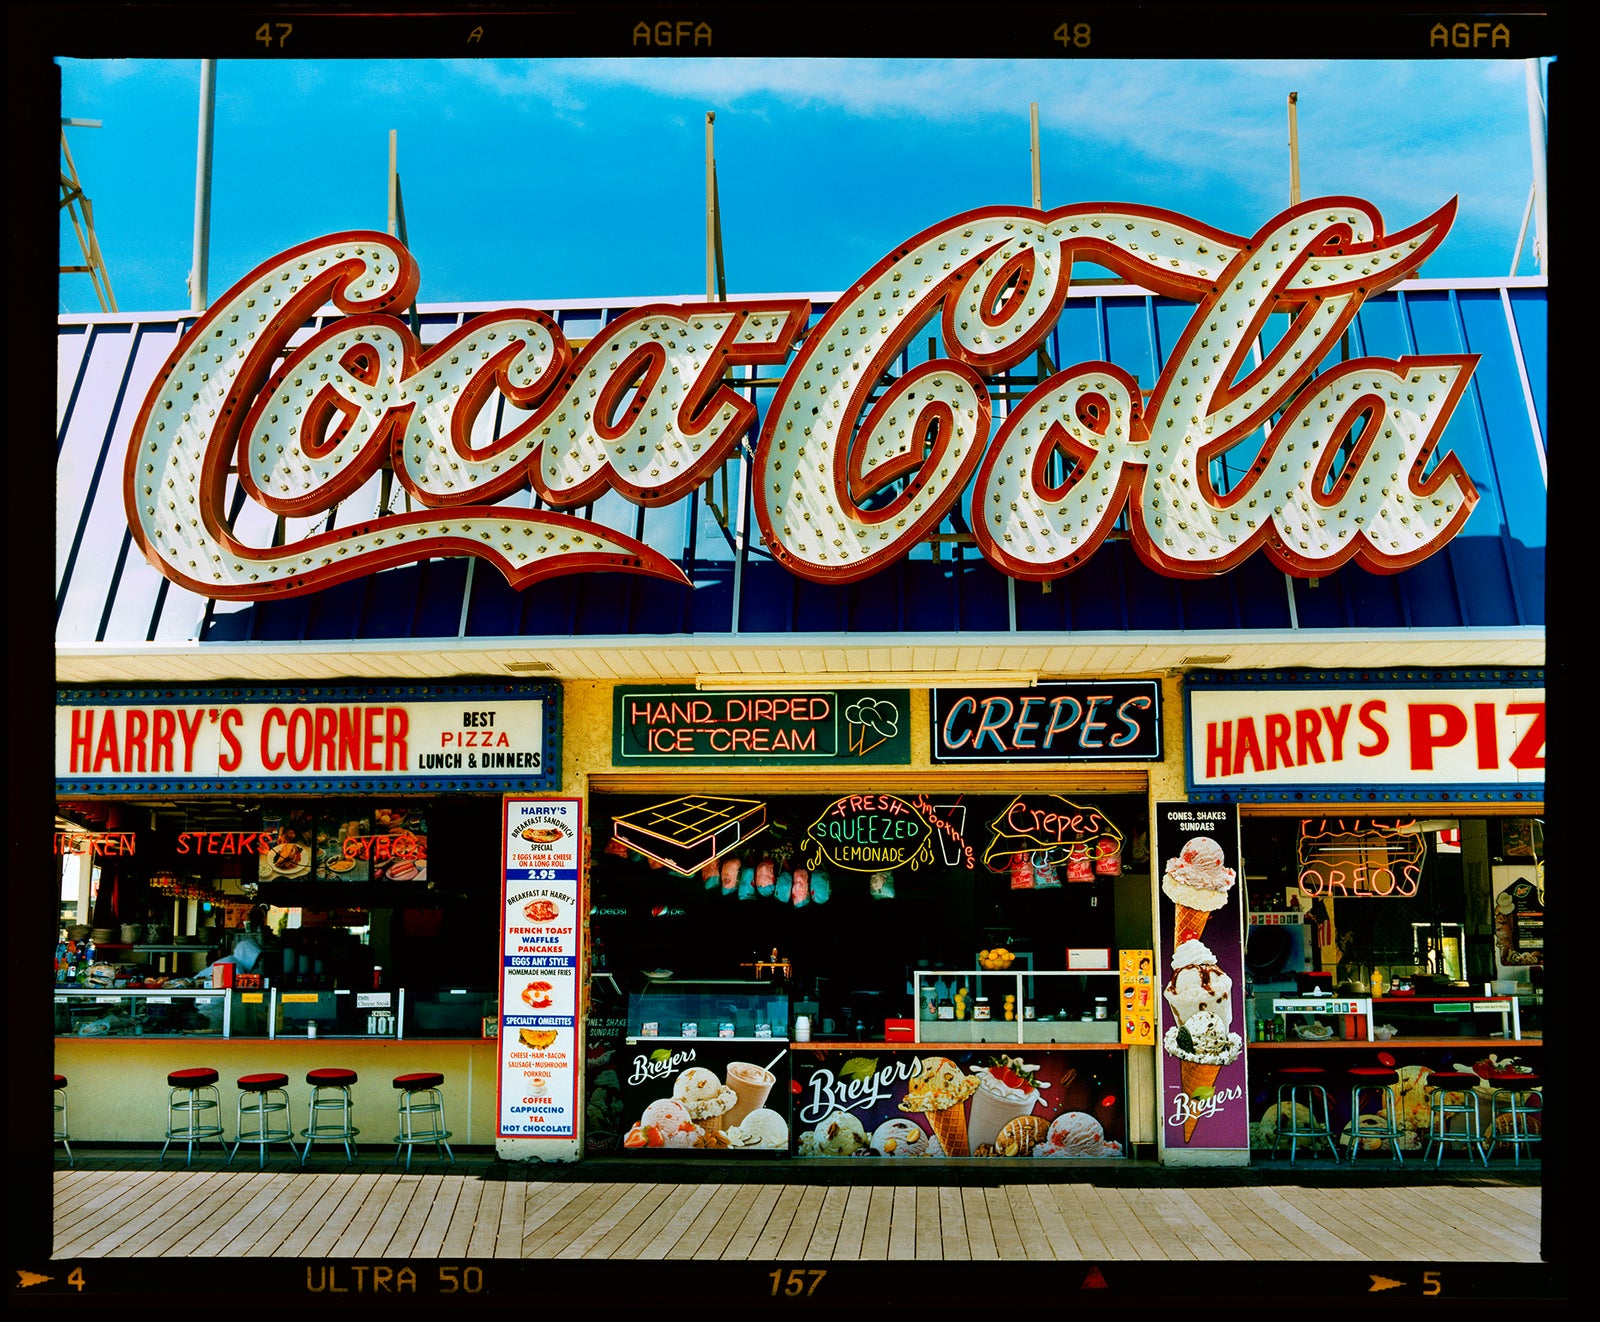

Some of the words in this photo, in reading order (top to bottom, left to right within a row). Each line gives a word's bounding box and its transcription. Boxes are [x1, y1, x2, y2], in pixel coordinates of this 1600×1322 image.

[256, 23, 292, 48] 47
[467, 26, 484, 44] A
[633, 21, 713, 47] AGFA
[1054, 23, 1091, 48] 48
[1430, 21, 1510, 48] AGFA
[463, 711, 496, 728] BEST
[631, 701, 712, 725] HAND
[943, 696, 1152, 753] CREPES
[69, 708, 243, 773] HARRY'S
[260, 707, 409, 772] CORNER
[441, 731, 510, 748] PIZZA
[648, 728, 695, 752] ICE
[709, 727, 816, 752] CREAM
[1205, 699, 1390, 779] HARRYS
[419, 753, 462, 769] LUNCH
[468, 752, 477, 769] &
[481, 752, 541, 769] DINNERS
[521, 807, 567, 815] HARRY'S
[1008, 802, 1102, 842] Crepes
[1167, 811, 1196, 821] CONES,
[1196, 811, 1227, 820] SHAKES
[511, 816, 542, 838] BREAKFAST
[543, 816, 574, 838] SANDWICH
[817, 815, 919, 844] SQUEEZED
[1180, 822, 1215, 831] SUNDAES
[176, 832, 274, 856] STEAKS
[834, 846, 906, 863] LEMONADE
[528, 870, 556, 880] 2.95
[1300, 865, 1420, 897] OREOS
[507, 889, 540, 906] BREAKFAST
[550, 890, 576, 906] HARRY'S
[599, 908, 627, 916] pepsi
[522, 936, 559, 944] WAFFLES
[508, 968, 539, 976] HOMEMADE
[540, 968, 557, 976] HOME
[557, 968, 572, 976] FRIES
[511, 957, 532, 966] EGGS
[532, 957, 548, 966] ANY
[549, 957, 569, 966] STYLE
[367, 1016, 395, 1034] HOT
[506, 1017, 537, 1026] SPECIALTY
[537, 1017, 572, 1026] OMELETTES
[628, 1048, 697, 1086] Breyers
[800, 1054, 924, 1124] Breyers
[1168, 1084, 1243, 1126] Breyers
[523, 1125, 572, 1133] CHOCOLATE
[67, 1267, 85, 1292] 4
[307, 1266, 416, 1293] ULTRA
[439, 1266, 483, 1293] 50
[768, 1268, 827, 1296] 157
[1423, 1271, 1442, 1295] 5
